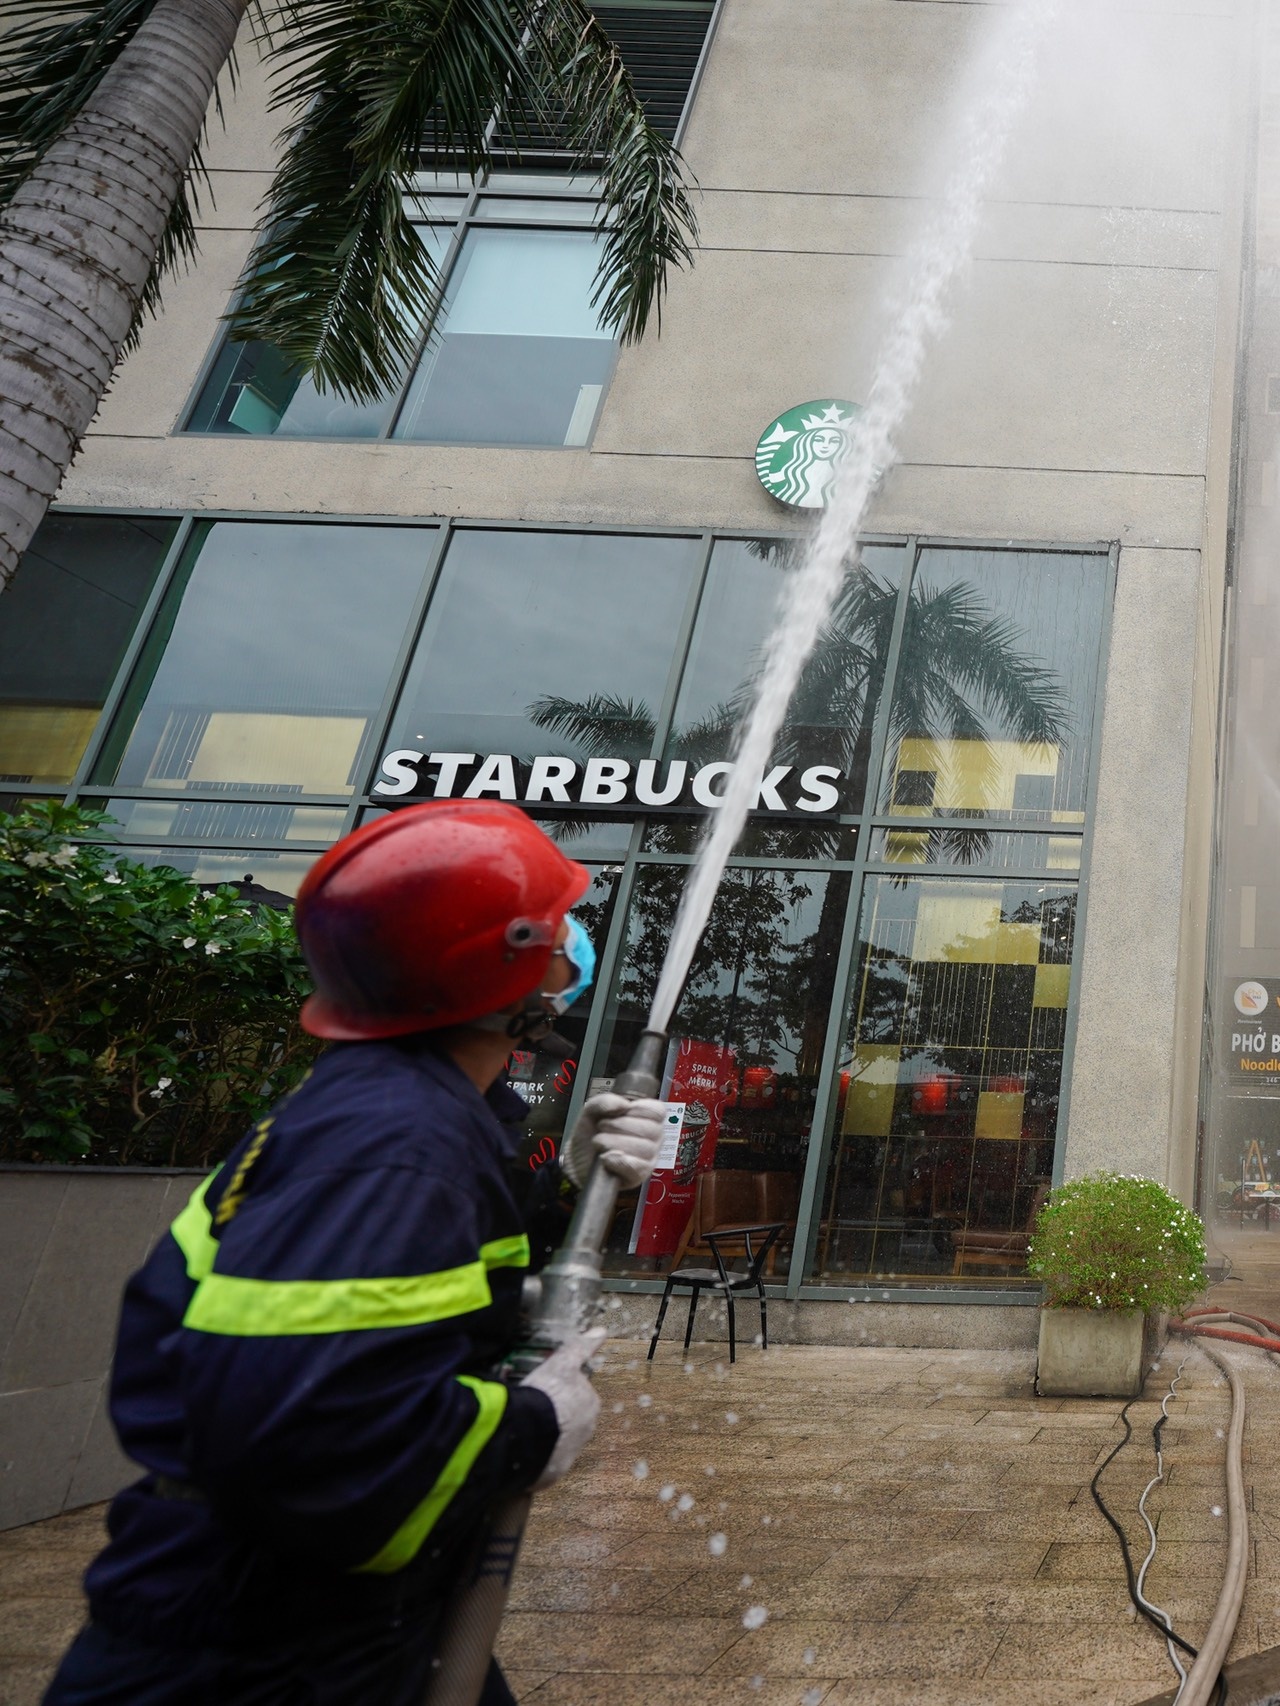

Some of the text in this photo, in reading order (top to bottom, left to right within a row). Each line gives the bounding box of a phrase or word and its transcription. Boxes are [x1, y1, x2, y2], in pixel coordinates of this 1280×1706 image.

[373, 748, 844, 813] STARBUCKS
[1231, 1026, 1267, 1053] PHỞ
[691, 1063, 717, 1075] SPARK
[506, 1081, 545, 1092] SPARK
[688, 1076, 717, 1089] MERRY
[521, 1095, 545, 1104] RRY
